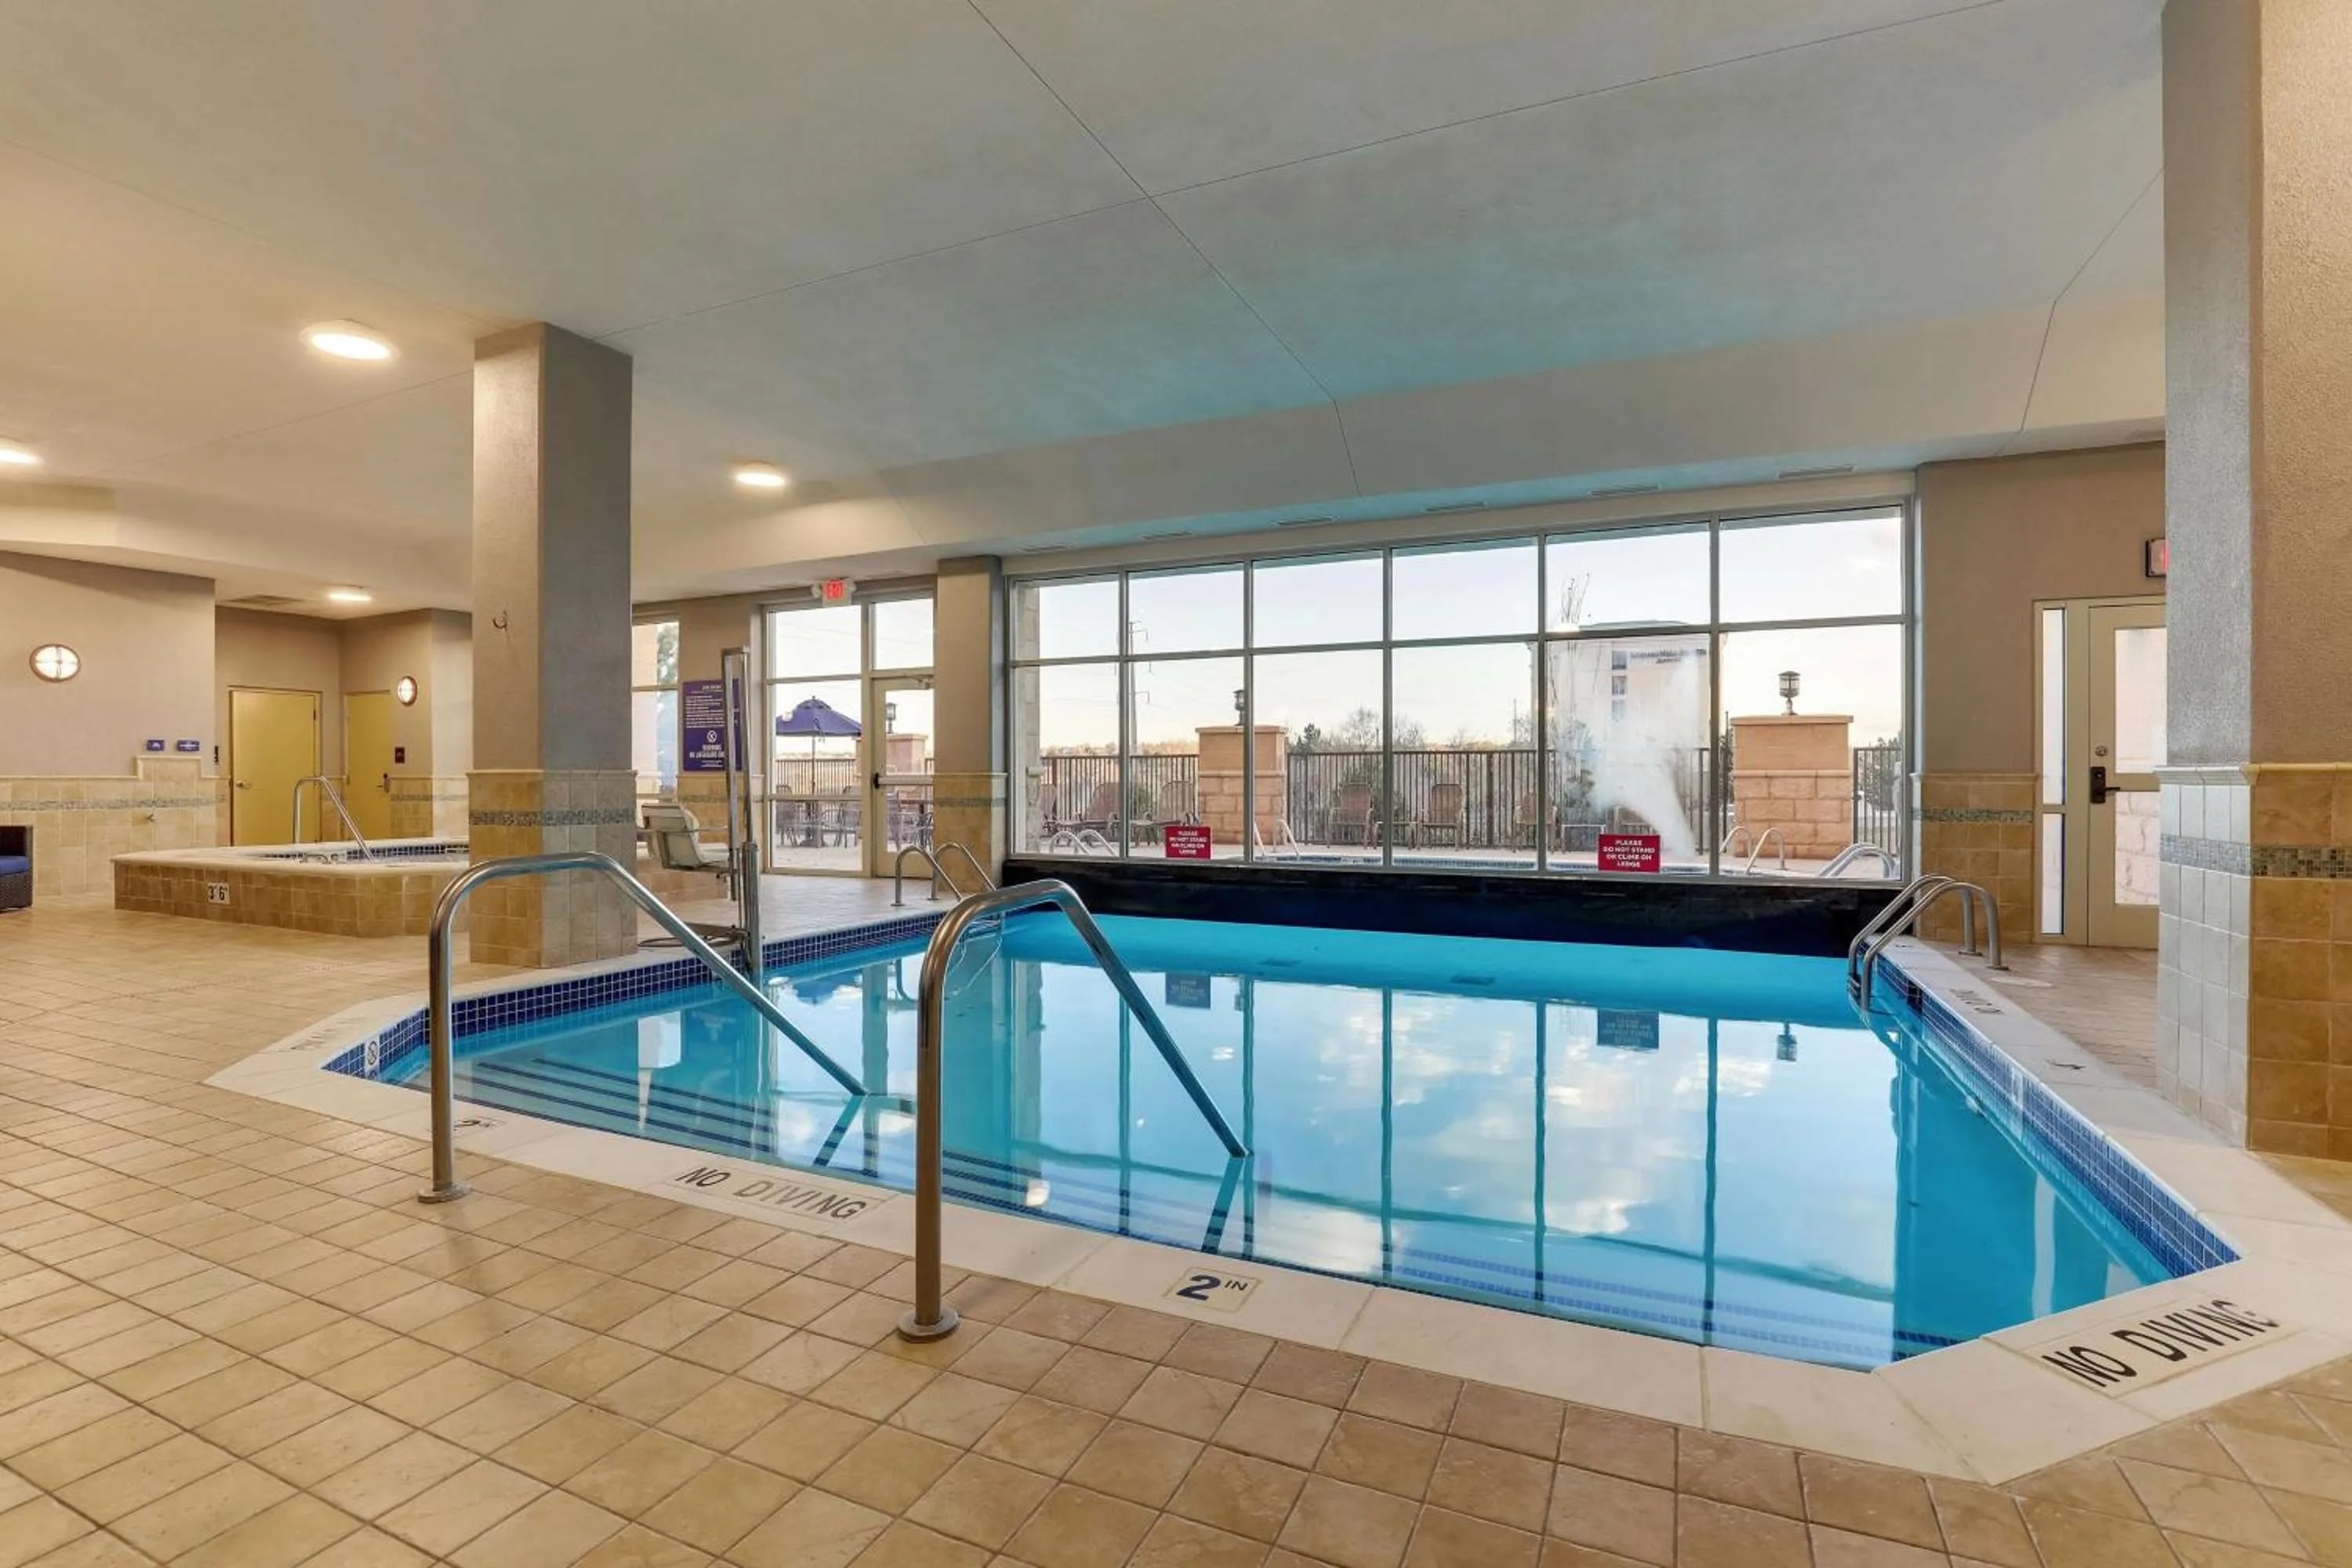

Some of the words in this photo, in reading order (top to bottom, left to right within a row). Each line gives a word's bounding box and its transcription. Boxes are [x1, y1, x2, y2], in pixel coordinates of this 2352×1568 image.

[675, 1167, 731, 1188] NO
[732, 1179, 867, 1219] DIVING
[1176, 1274, 1221, 1301] 2
[1224, 1279, 1248, 1291] IN
[2041, 1345, 2138, 1388] NO
[2109, 1298, 2280, 1362] DIVING
